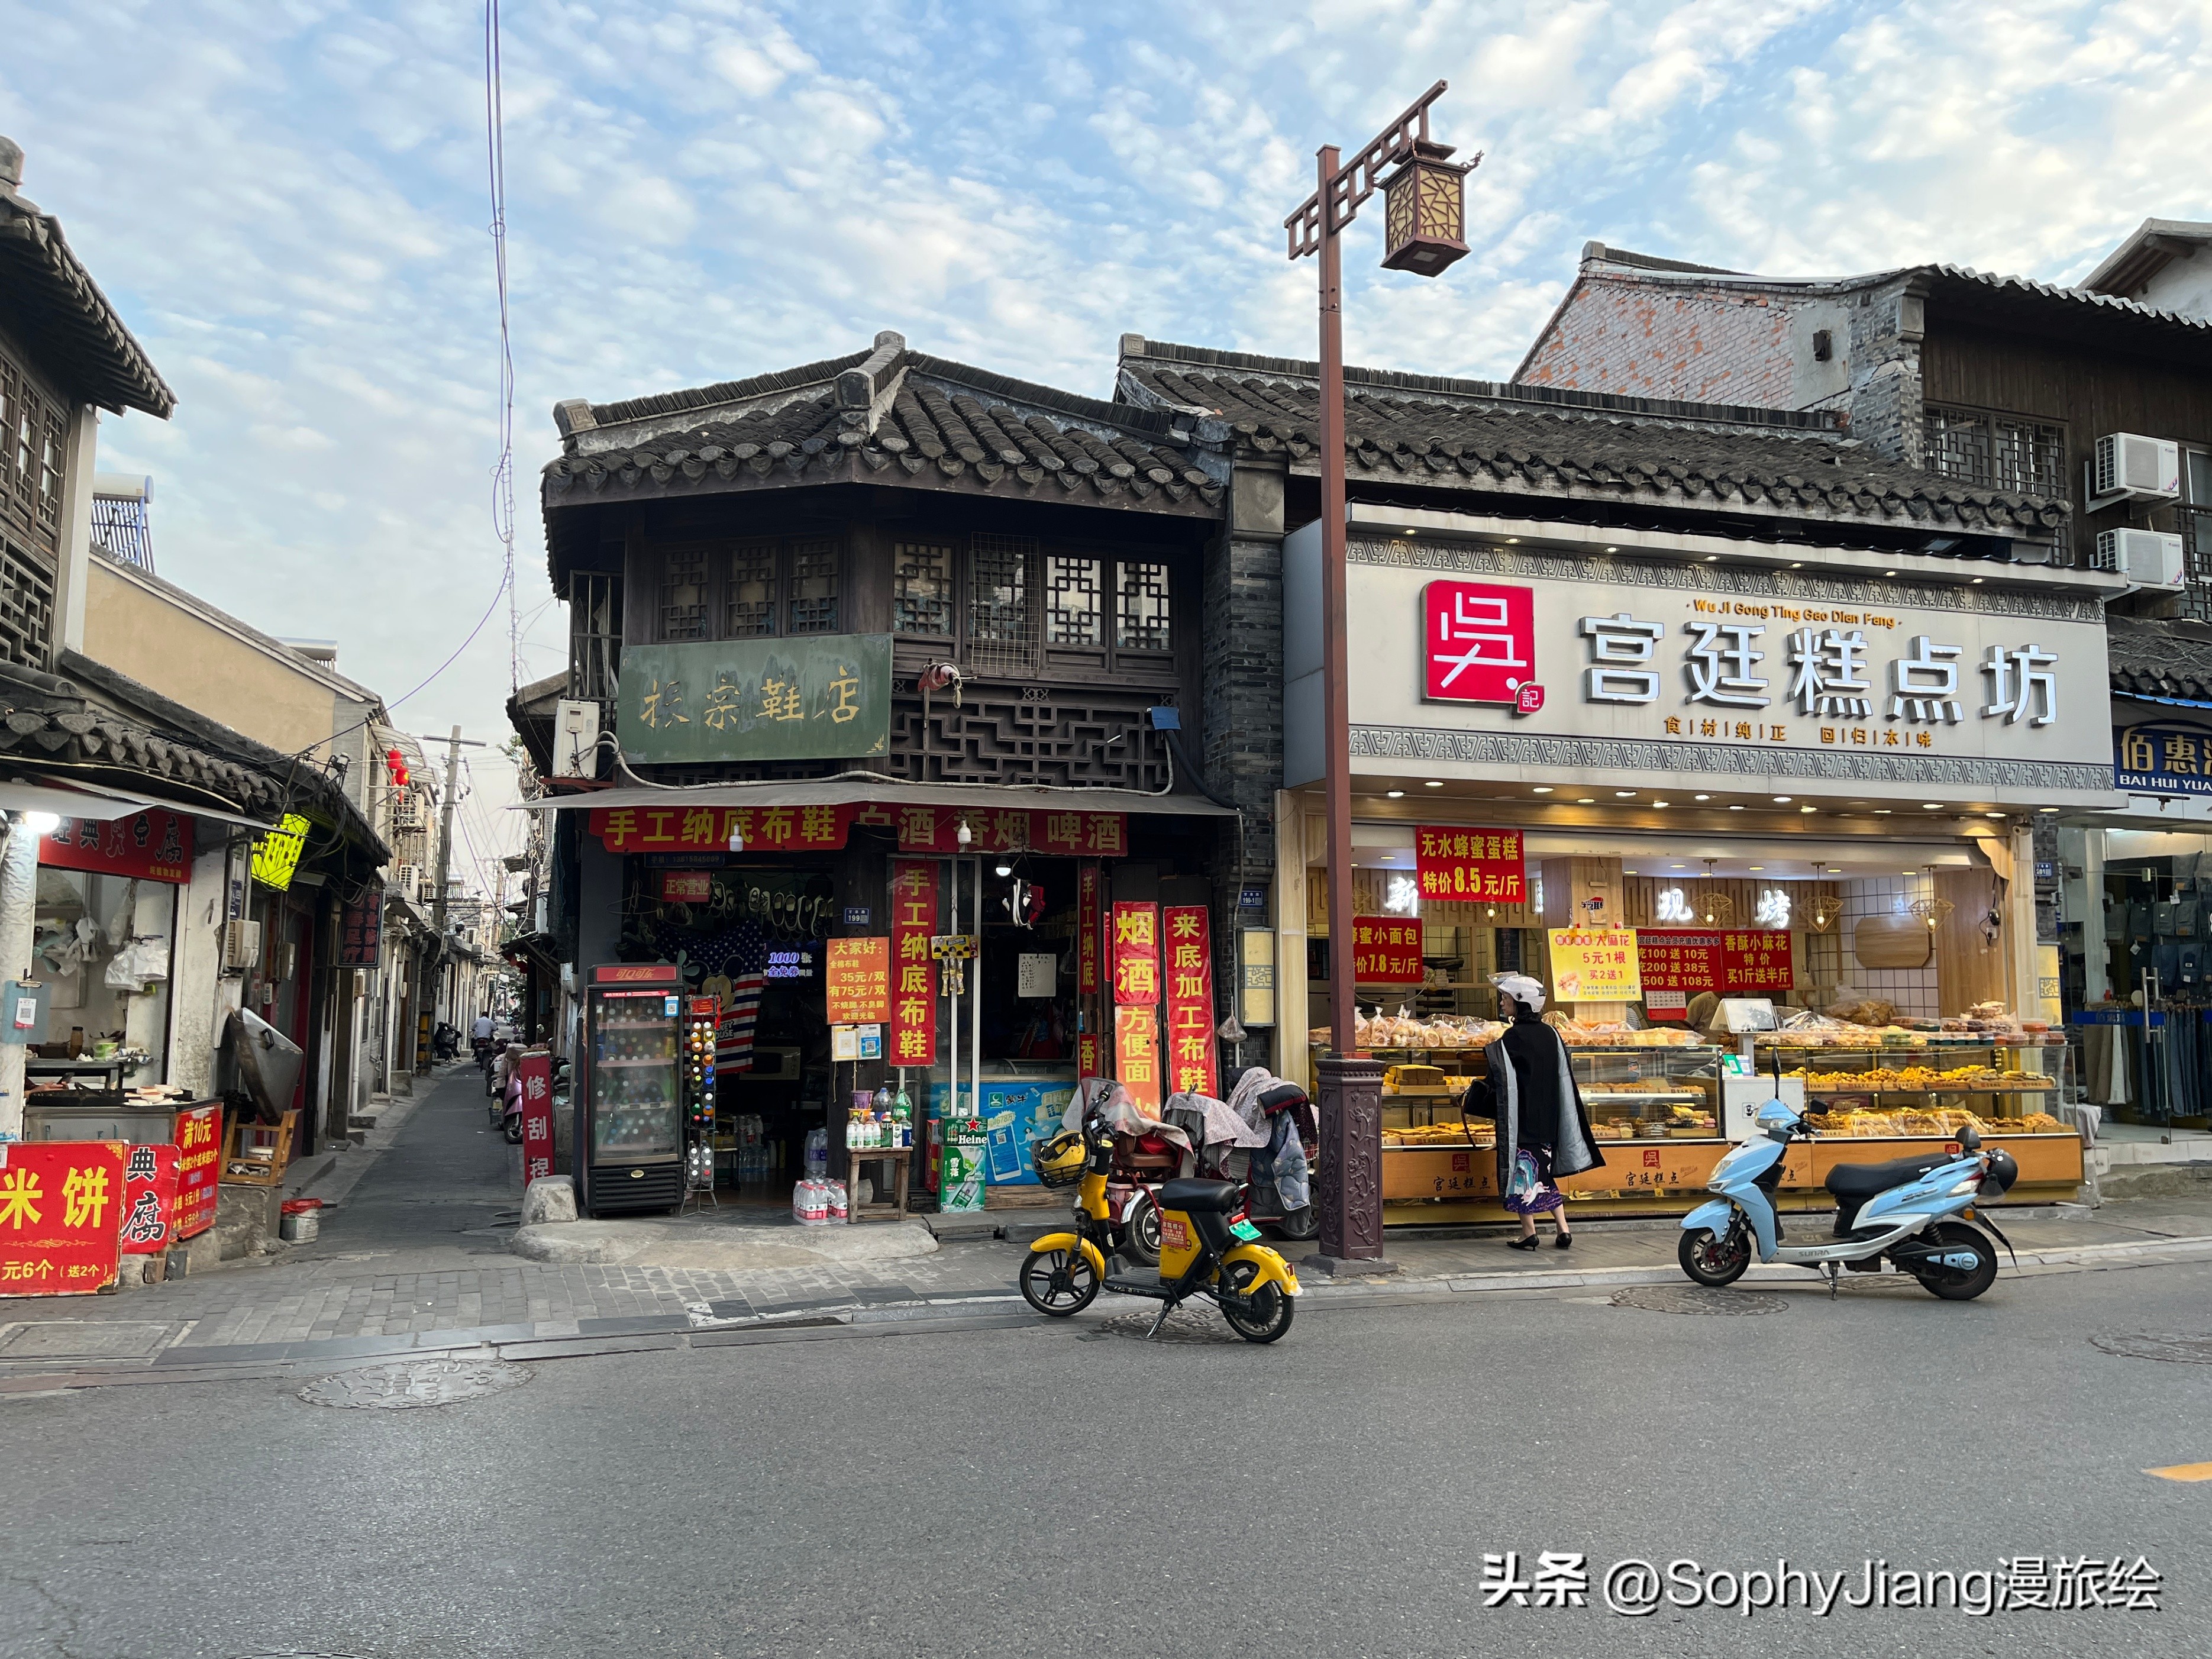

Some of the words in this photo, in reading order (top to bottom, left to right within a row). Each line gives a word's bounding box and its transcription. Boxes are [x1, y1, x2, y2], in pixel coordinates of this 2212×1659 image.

[1694, 599, 1715, 612] Wu
[1719, 601, 1731, 614] Ji
[1735, 603, 1768, 619] Gong
[1771, 605, 1800, 622] Ting
[1803, 608, 1829, 621] Gao
[1832, 610, 1859, 624] Dian
[1864, 613, 1895, 628] Fang
[1579, 612, 2059, 728] 宫廷糕点坊
[2120, 775, 2146, 786] BAI
[2151, 777, 2177, 789] HUI
[605, 806, 837, 846] 手工纳底布鞋
[1047, 812, 1120, 850] 啤酒
[1422, 833, 1518, 861] 无水蜂蜜蛋糕
[665, 878, 709, 895] 正常营业
[1083, 874, 1094, 993] 手工纳底
[1596, 934, 1630, 946] 大麻花
[1637, 936, 1720, 947] 宫廷糕点会员充值优惠多多
[1725, 934, 1787, 951] 香酥小麻花
[768, 952, 799, 964] 1000
[1116, 910, 1155, 993] 烟酒
[1583, 951, 1626, 964] 5元1根
[1670, 948, 1680, 959] 送
[1684, 948, 1709, 960] 10元
[1744, 953, 1770, 966] 特价
[830, 960, 859, 969] 全棉布鞋
[899, 869, 930, 1058] 手工纳底布鞋
[1353, 954, 1418, 974] 价7.8元/斤
[1670, 961, 1681, 973] 送
[1684, 963, 1709, 973] 38元
[840, 971, 886, 982] 35元/双
[1590, 970, 1623, 980] 买2送1
[1667, 975, 1678, 986] 送
[1682, 976, 1713, 986] 108元
[1727, 967, 1789, 983] 买1斤送半斤
[829, 985, 886, 997] 有75元/双
[1173, 913, 1208, 1093] 来底加工布鞋
[842, 1012, 876, 1020] 欢迎光临
[1122, 1006, 1151, 1083] 方便面
[1081, 1040, 1094, 1070] 香
[183, 1117, 211, 1149] 满10元
[127, 1147, 157, 1182] 典
[1433, 1176, 1490, 1192] 宫廷糕点
[1626, 1171, 1679, 1187] 宫廷糕点
[0, 1166, 109, 1229] 米饼
[122, 1190, 166, 1242] 腐
